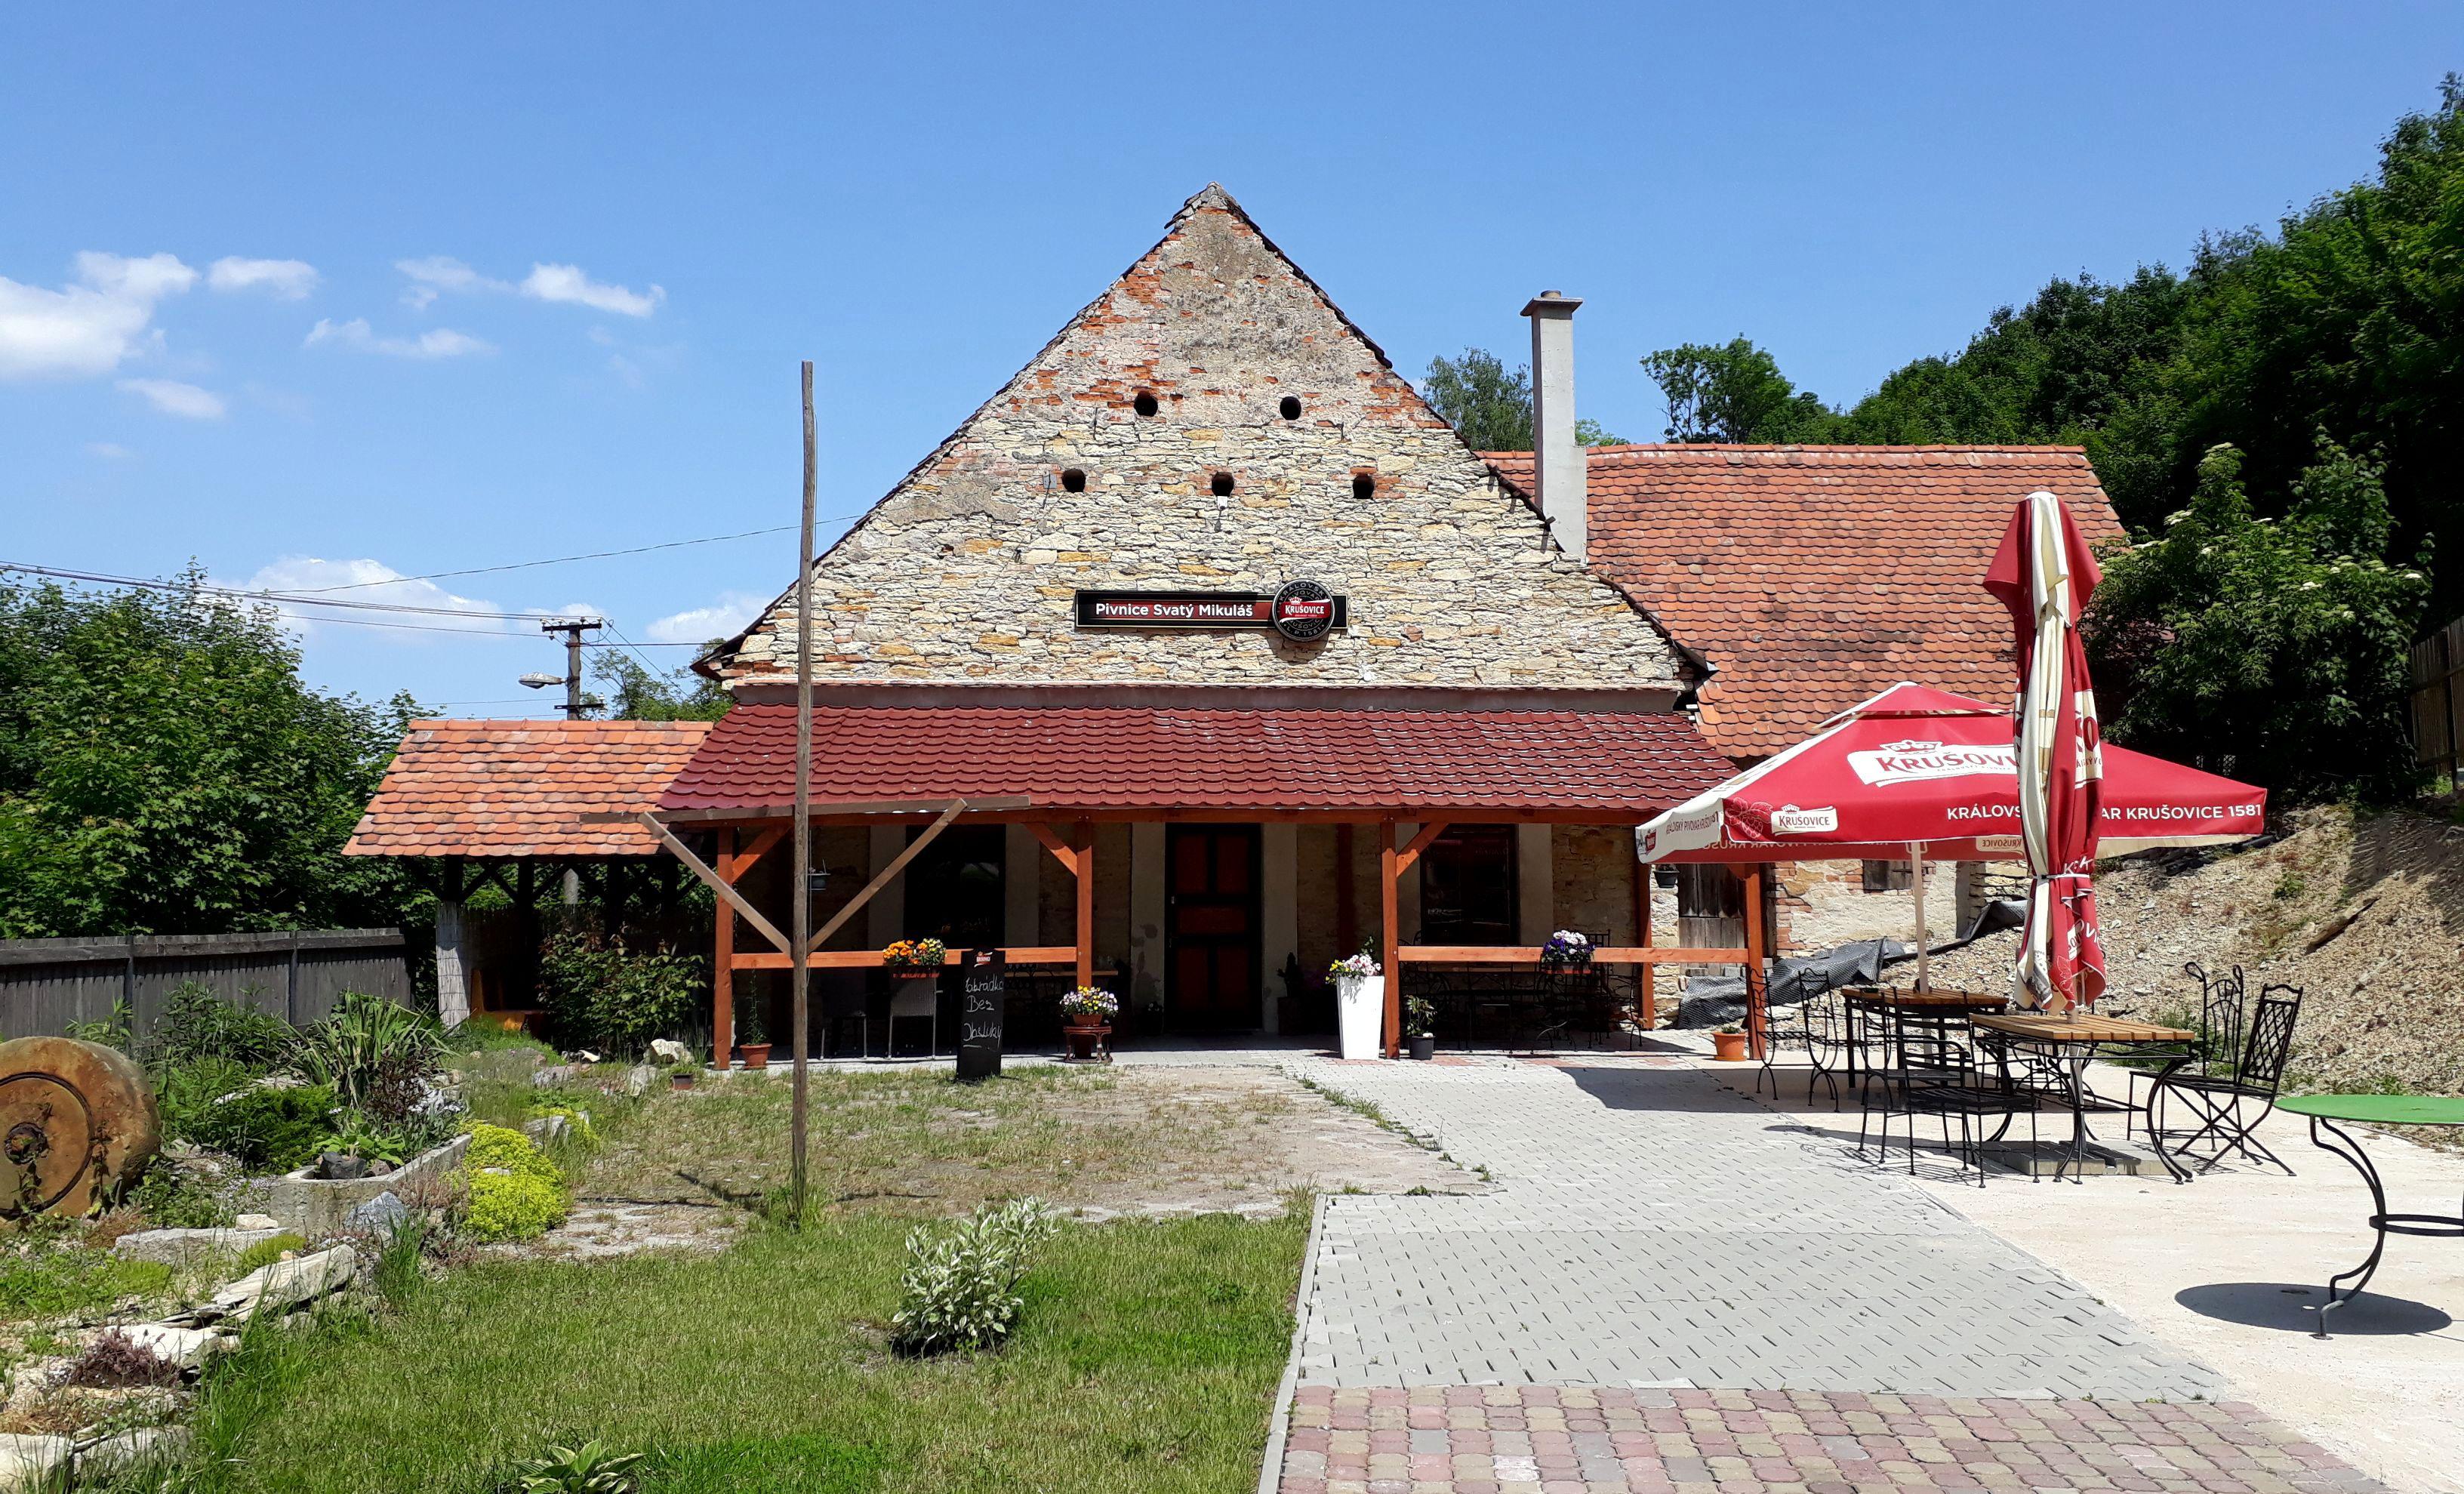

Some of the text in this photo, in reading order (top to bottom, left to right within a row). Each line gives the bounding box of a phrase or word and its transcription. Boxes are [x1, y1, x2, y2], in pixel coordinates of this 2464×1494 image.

[1096, 603, 1253, 618] Pivnice Svatý Mikuláš
[1285, 605, 1325, 615] KRUŠOVICE
[1875, 751, 2018, 774] KRUŠOVI
[1947, 803, 2021, 820] KRÁLOVS
[2127, 804, 2224, 820] KRUŠOVICE
[2228, 804, 2261, 817] 1581
[1779, 815, 1831, 829] KRUŠOVICE
